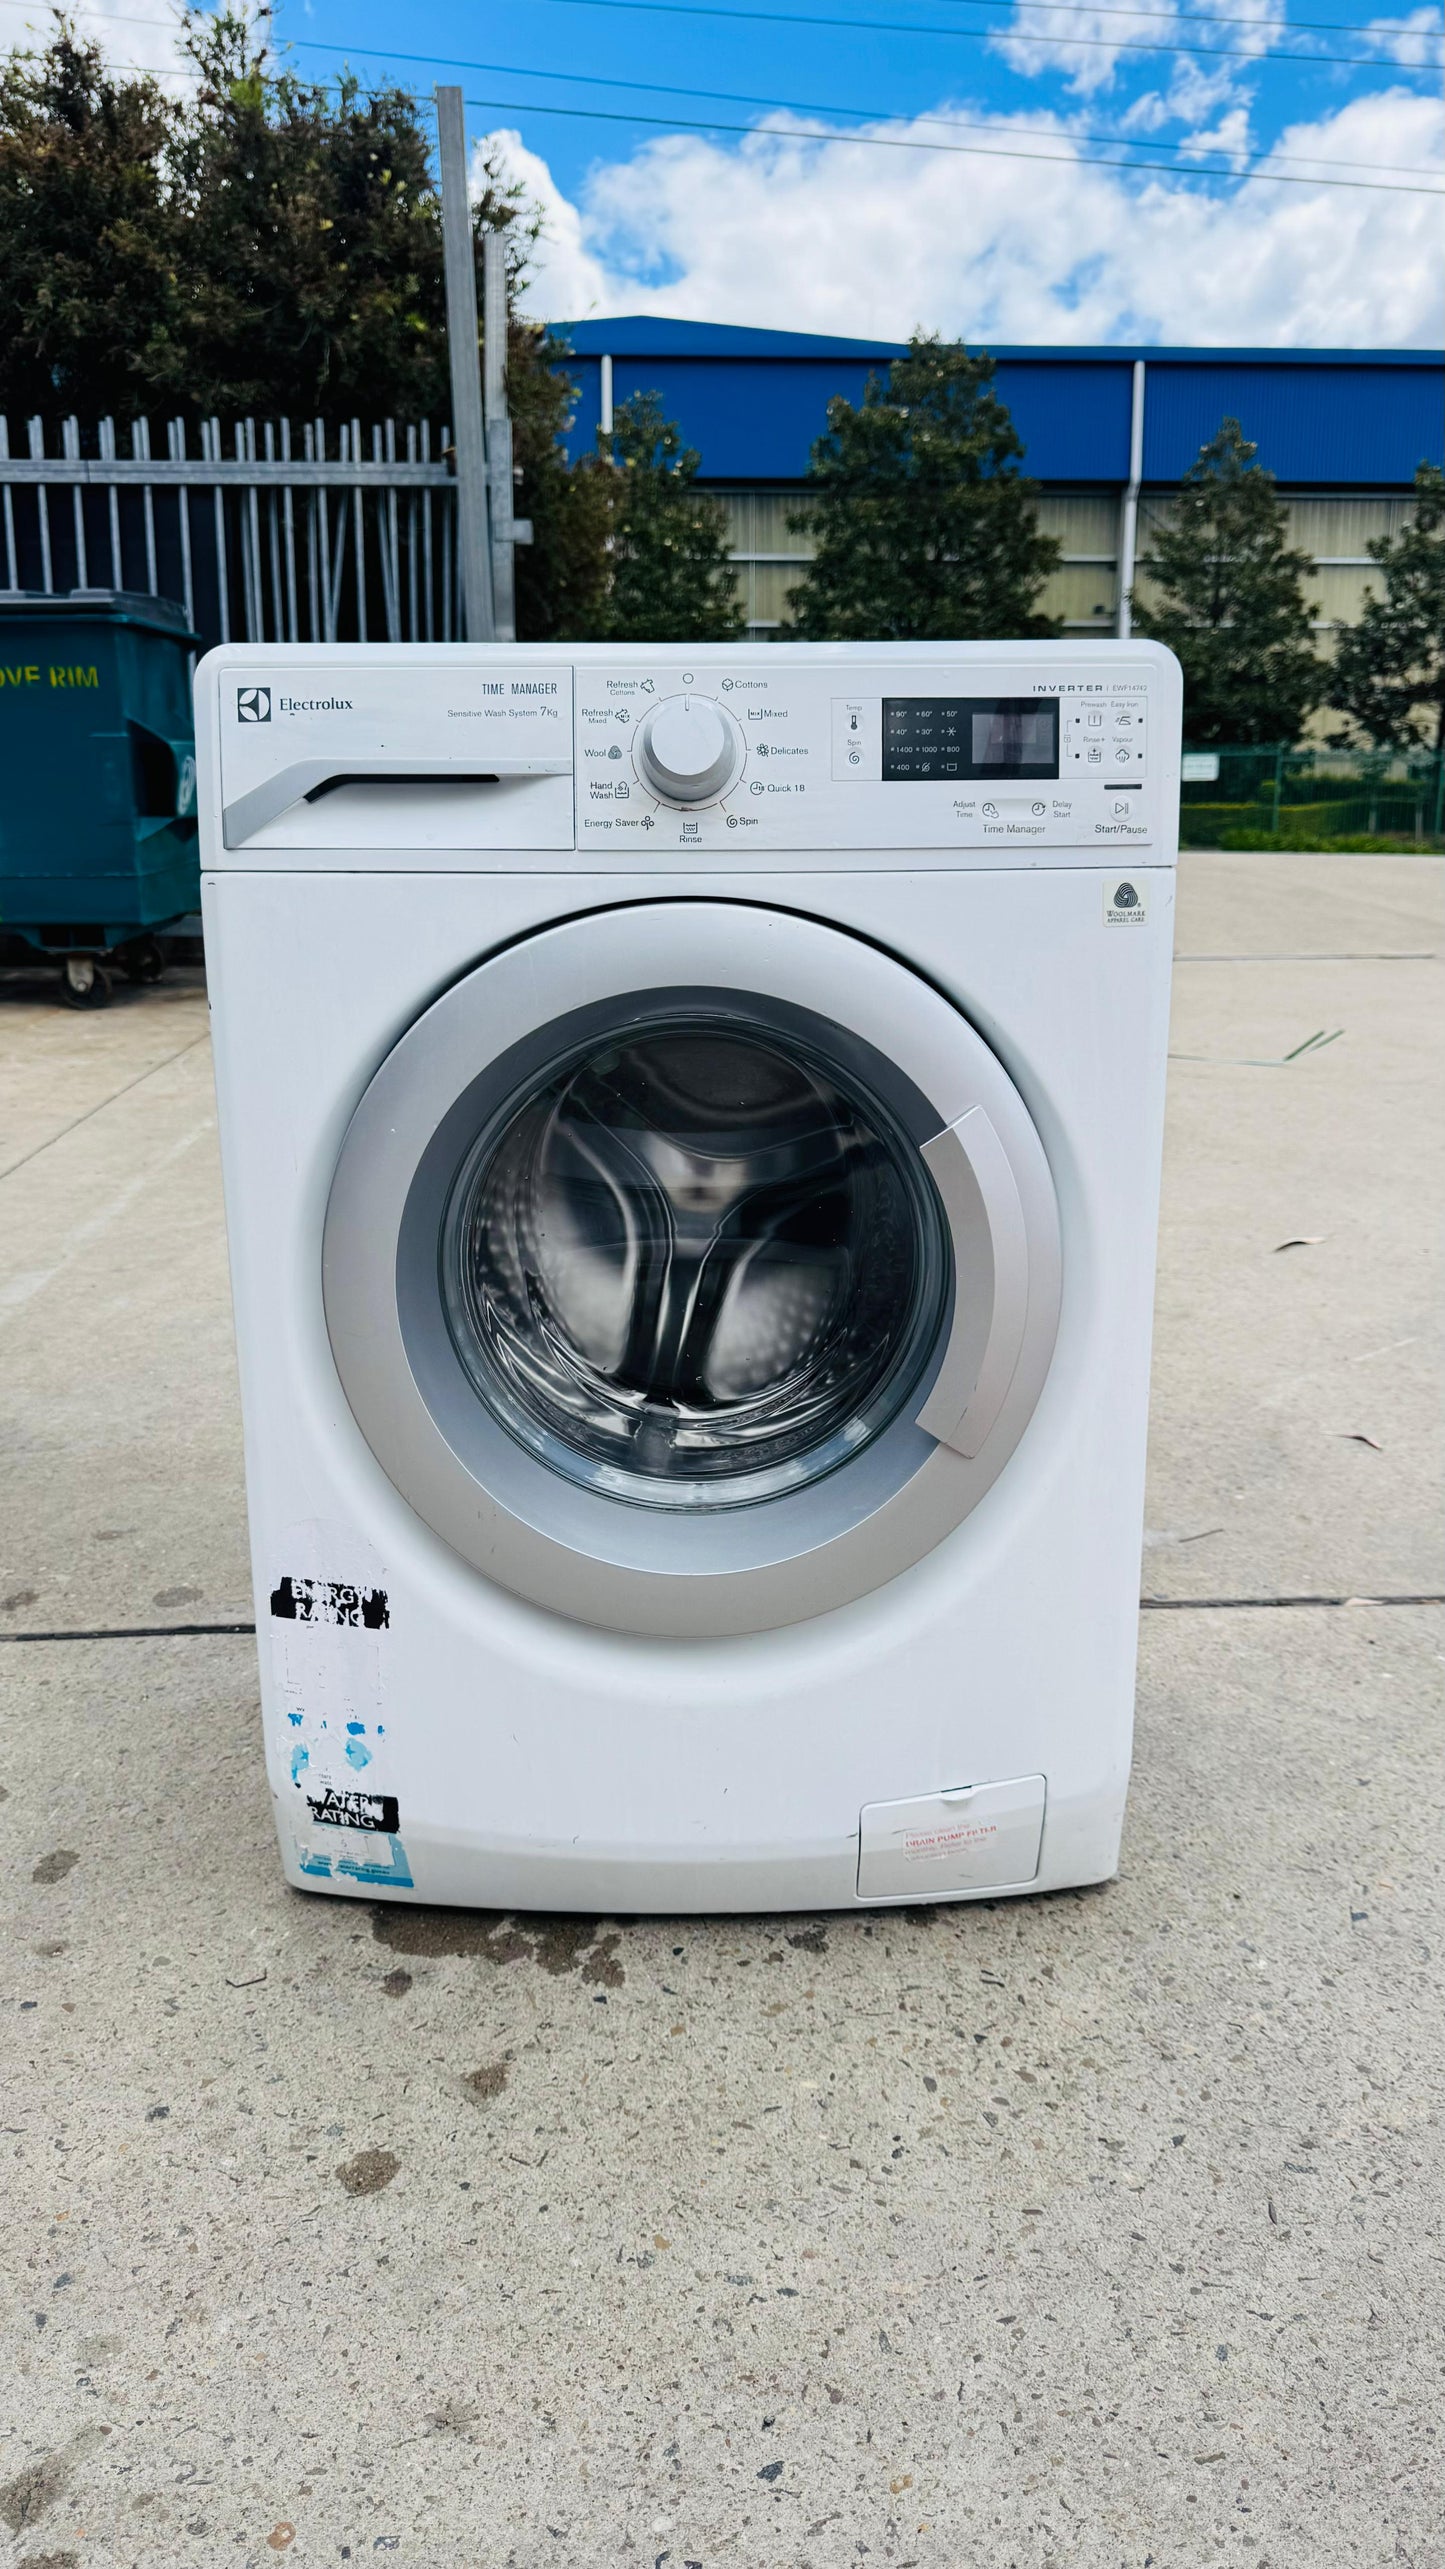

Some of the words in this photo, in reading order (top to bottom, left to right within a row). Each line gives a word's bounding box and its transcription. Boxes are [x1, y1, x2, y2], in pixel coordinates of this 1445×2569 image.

[49, 666, 99, 688] RIM
[482, 683, 504, 695] TIME
[511, 682, 557, 695] MANAGER
[606, 680, 638, 689] Refresh
[735, 680, 768, 689] Cottons
[279, 697, 354, 711] Electrolux
[1111, 701, 1126, 709] Easy
[447, 709, 482, 718] Sensitive
[485, 709, 507, 717] Wash
[508, 709, 537, 718] System
[540, 706, 558, 719] 7Kg
[581, 708, 614, 717] Refresh
[764, 709, 789, 718] Mixed
[584, 749, 607, 758] Wool
[770, 746, 809, 755] Delicates
[590, 781, 613, 790] Hand
[767, 784, 792, 793] Quick
[794, 784, 806, 792] 18
[589, 791, 614, 800] Wash
[953, 800, 976, 809] Adjust
[1052, 801, 1073, 810] Delay
[955, 811, 973, 819] Time
[1053, 811, 1071, 819] Start
[584, 818, 613, 829] Energy
[615, 818, 639, 827] Saver
[739, 817, 759, 826] Spin
[983, 824, 1005, 834] Time
[1006, 824, 1045, 835] Manager
[1095, 824, 1148, 834] Start/Pause
[679, 835, 703, 843] Rinse
[310, 1805, 376, 1828] RATING
